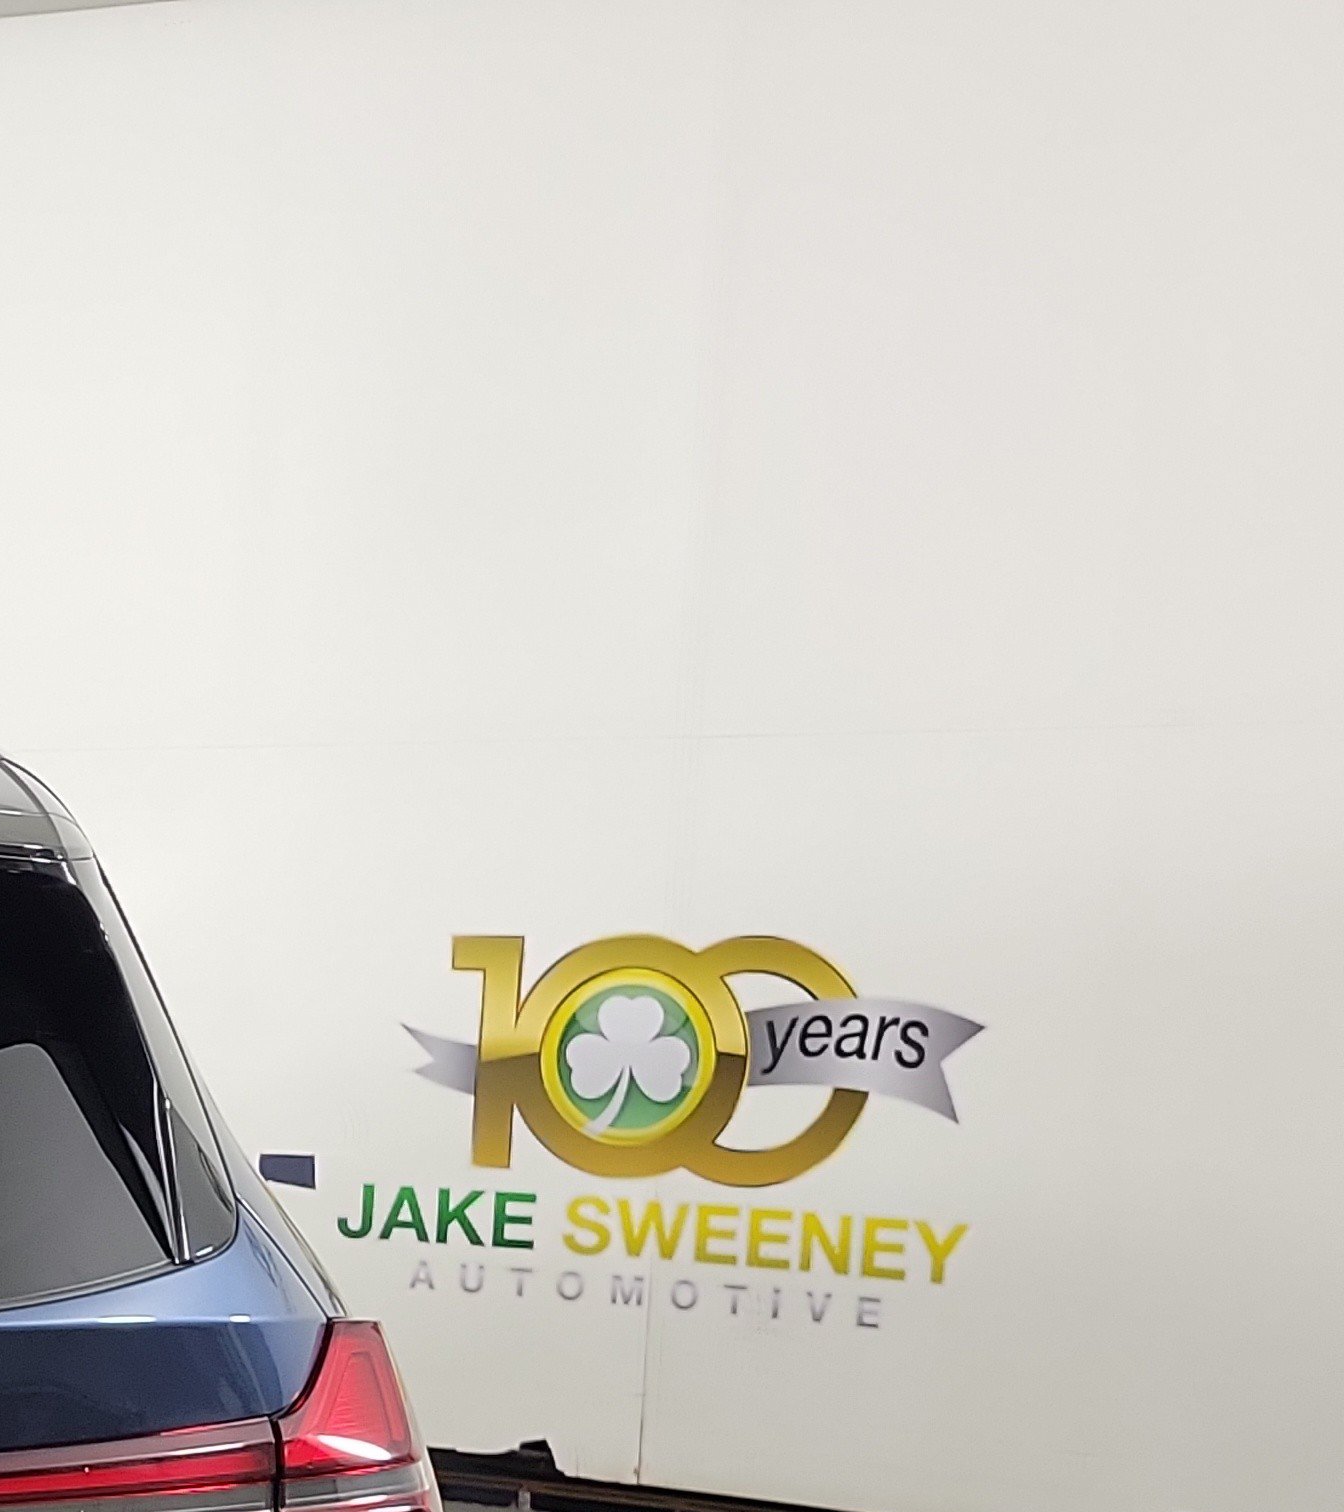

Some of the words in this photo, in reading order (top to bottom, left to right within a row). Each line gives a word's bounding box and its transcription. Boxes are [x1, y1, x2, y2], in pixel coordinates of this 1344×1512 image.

[451, 935, 869, 1188] 100
[760, 1009, 930, 1074] years
[336, 1183, 538, 1251] JAKE
[561, 1194, 968, 1285] SWEENEY
[409, 1259, 882, 1330] AUTOMOTIVE
